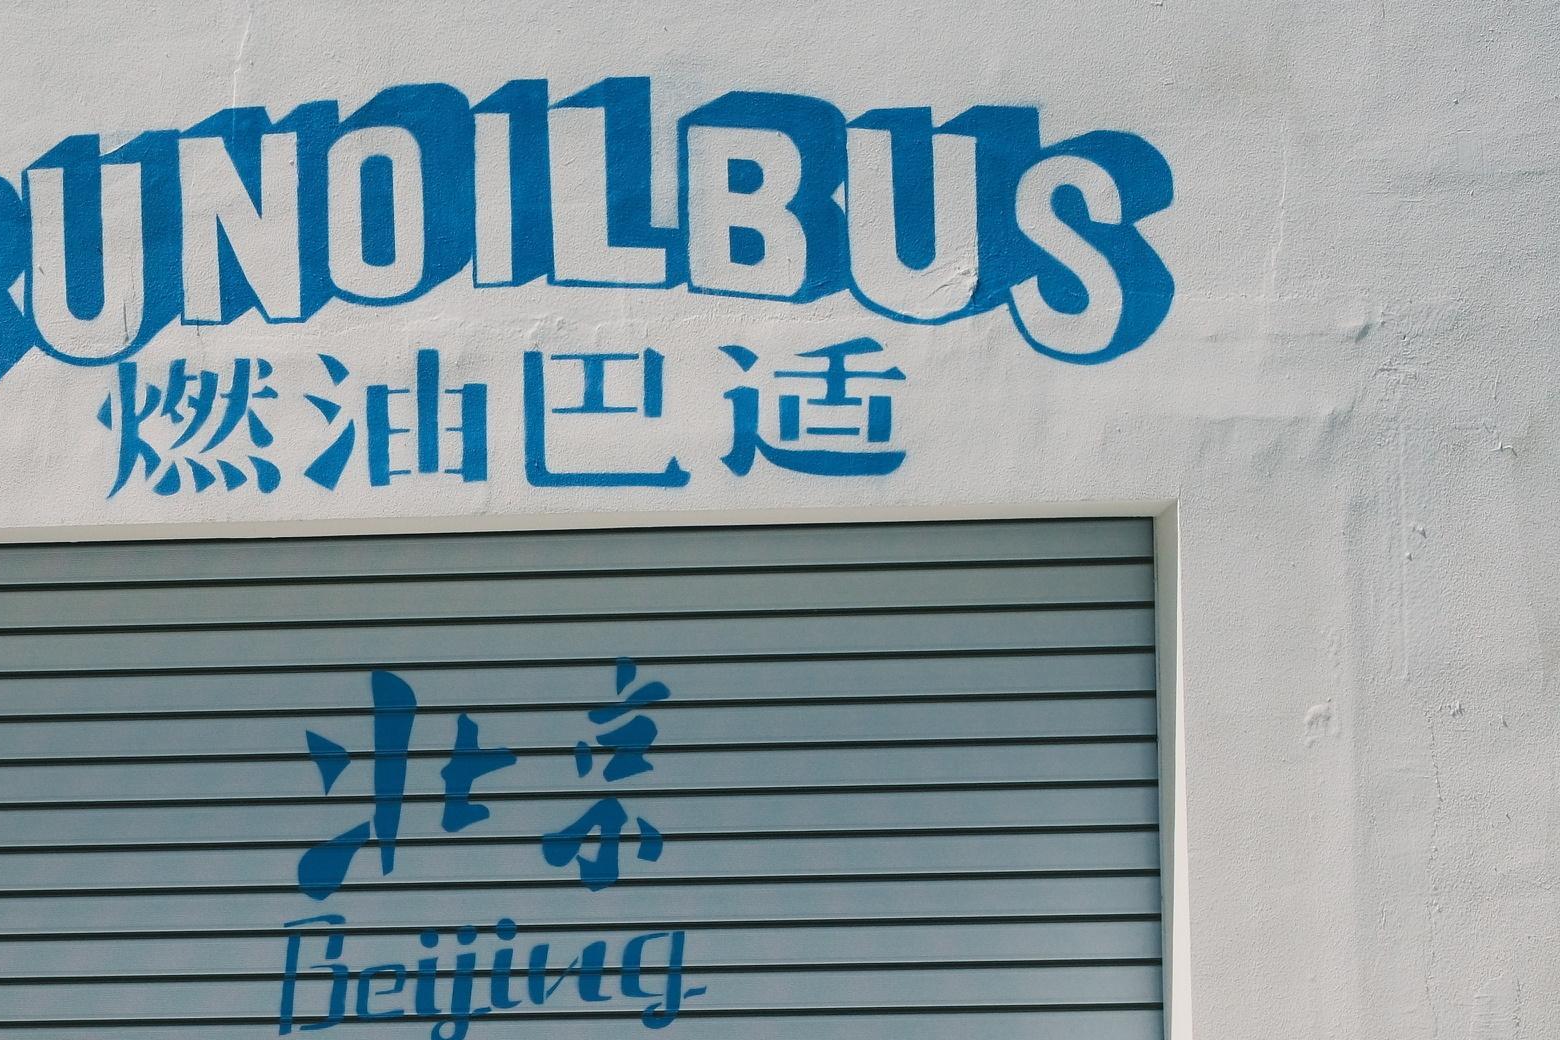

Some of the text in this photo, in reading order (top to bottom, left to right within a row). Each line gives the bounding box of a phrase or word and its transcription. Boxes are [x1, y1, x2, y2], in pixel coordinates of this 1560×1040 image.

[97, 337, 907, 499] 燃油巴适
[297, 656, 671, 900] 北京
